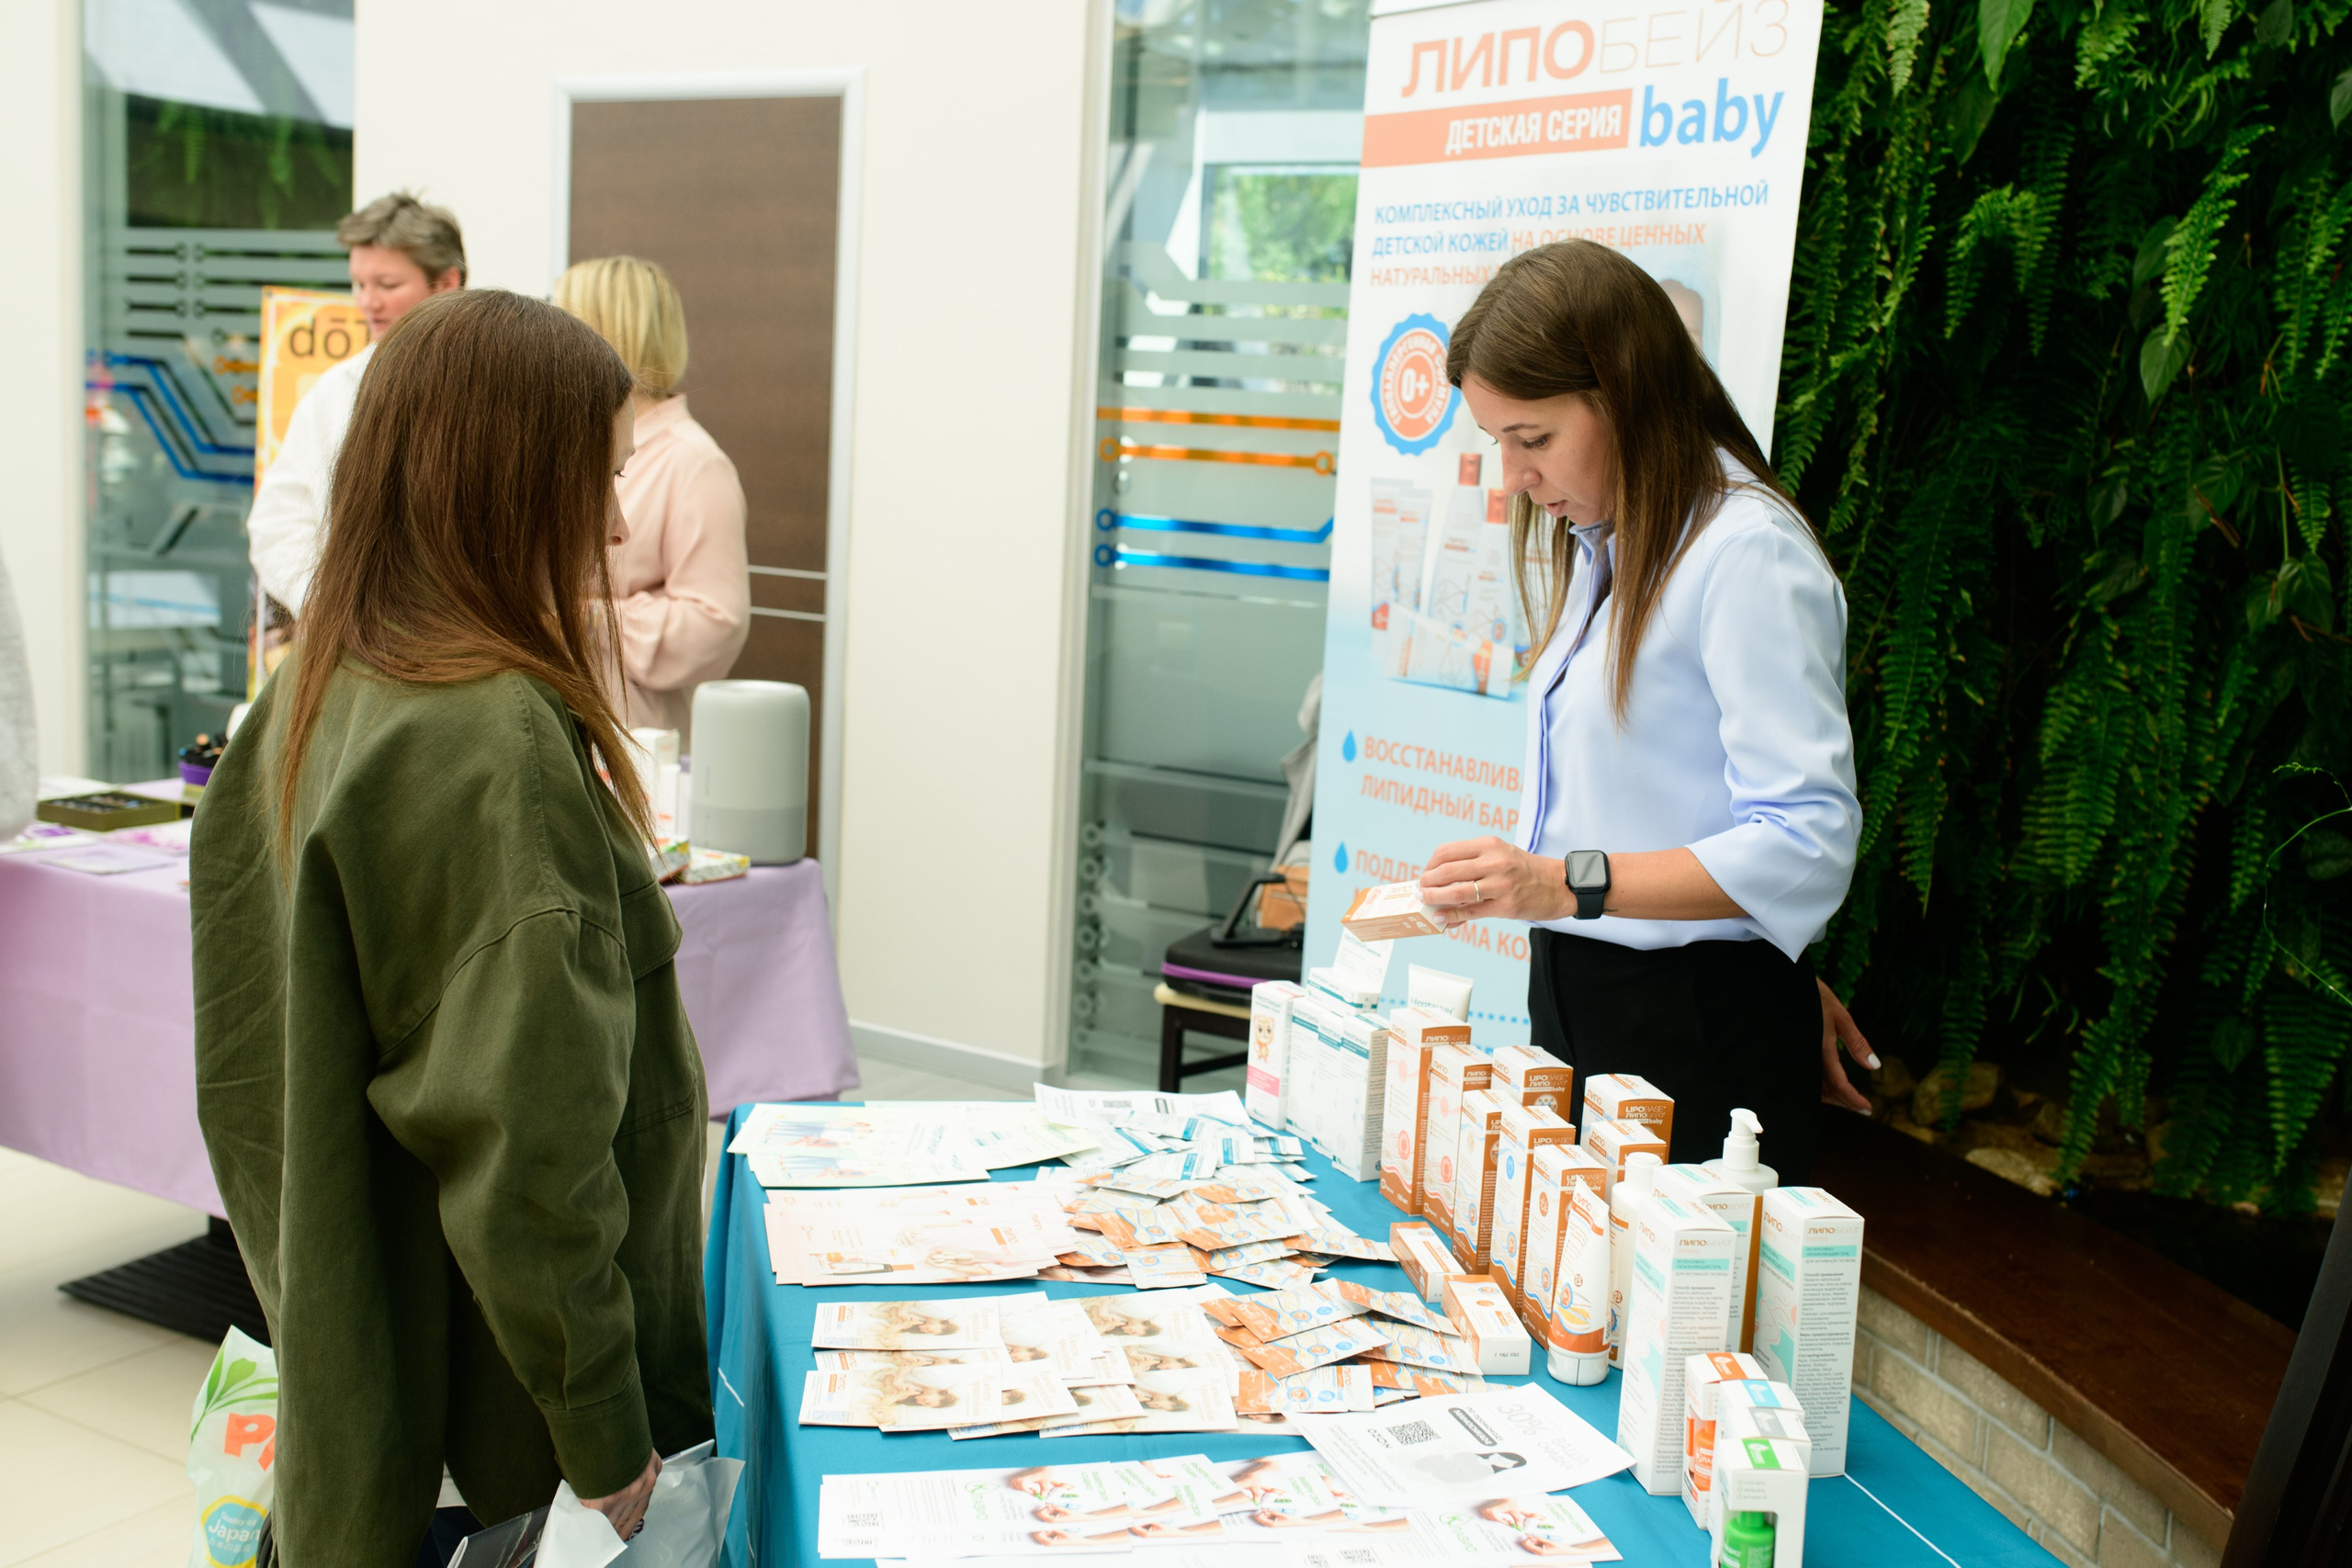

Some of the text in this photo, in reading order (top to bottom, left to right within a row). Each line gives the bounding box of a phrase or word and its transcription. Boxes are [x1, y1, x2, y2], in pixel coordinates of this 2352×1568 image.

[1401, 0, 1789, 97] ЛИПОБЕЙЗ
[1445, 105, 1622, 154] ДЕТСКАЯ СЕРИЯ
[1639, 77, 1784, 158] baby
[1375, 180, 1769, 223] КОМПЛЕКСНЫЙ УХОД ЗА ЧУВСТВИТЕЛЬНОЙ
[1373, 231, 1443, 258] ДЕТСКОЙ
[1449, 228, 1508, 252] КОЖЕЙ
[1512, 230, 1534, 250] НА
[1620, 223, 1705, 251] ЦЕННЫХ
[1371, 265, 1490, 287] НАТУРАЛЬНЫХ
[1401, 368, 1430, 402] 0+
[1363, 736, 1523, 793] ВОССТАНАВЛИВ
[1361, 774, 1475, 823] ЛИПИДНЫЙ
[1498, 928, 1532, 963] КО
[1367, 1427, 1393, 1449] OZON
[209, 1518, 260, 1543] Japan
